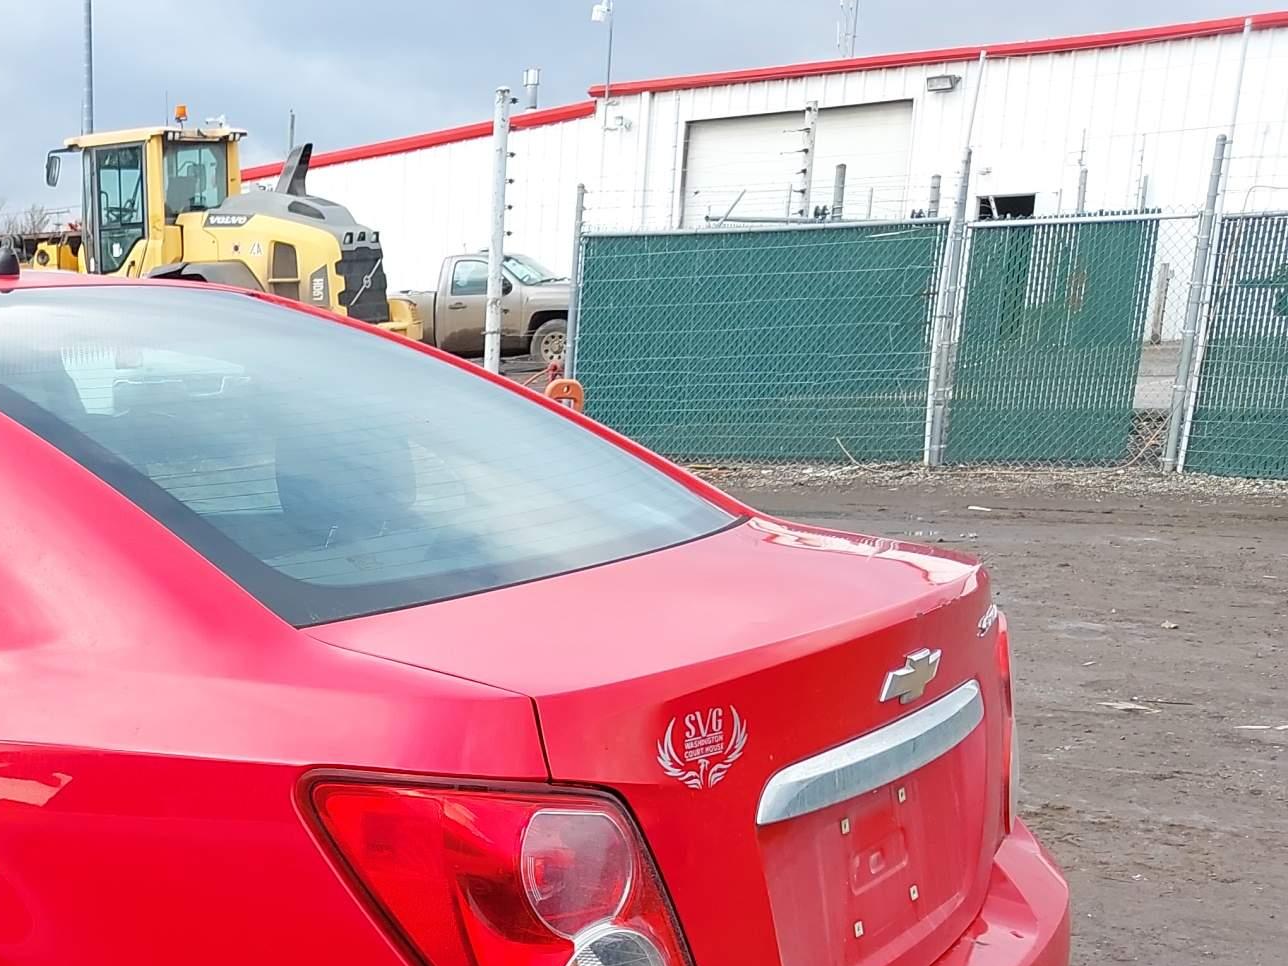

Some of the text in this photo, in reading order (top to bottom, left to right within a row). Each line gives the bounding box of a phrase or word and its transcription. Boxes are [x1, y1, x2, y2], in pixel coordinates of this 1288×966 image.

[209, 215, 248, 225] VOLVO
[684, 707, 724, 739] SVG
[684, 734, 724, 751] WASHINGTON
[684, 742, 724, 759] COURT HOUSE
